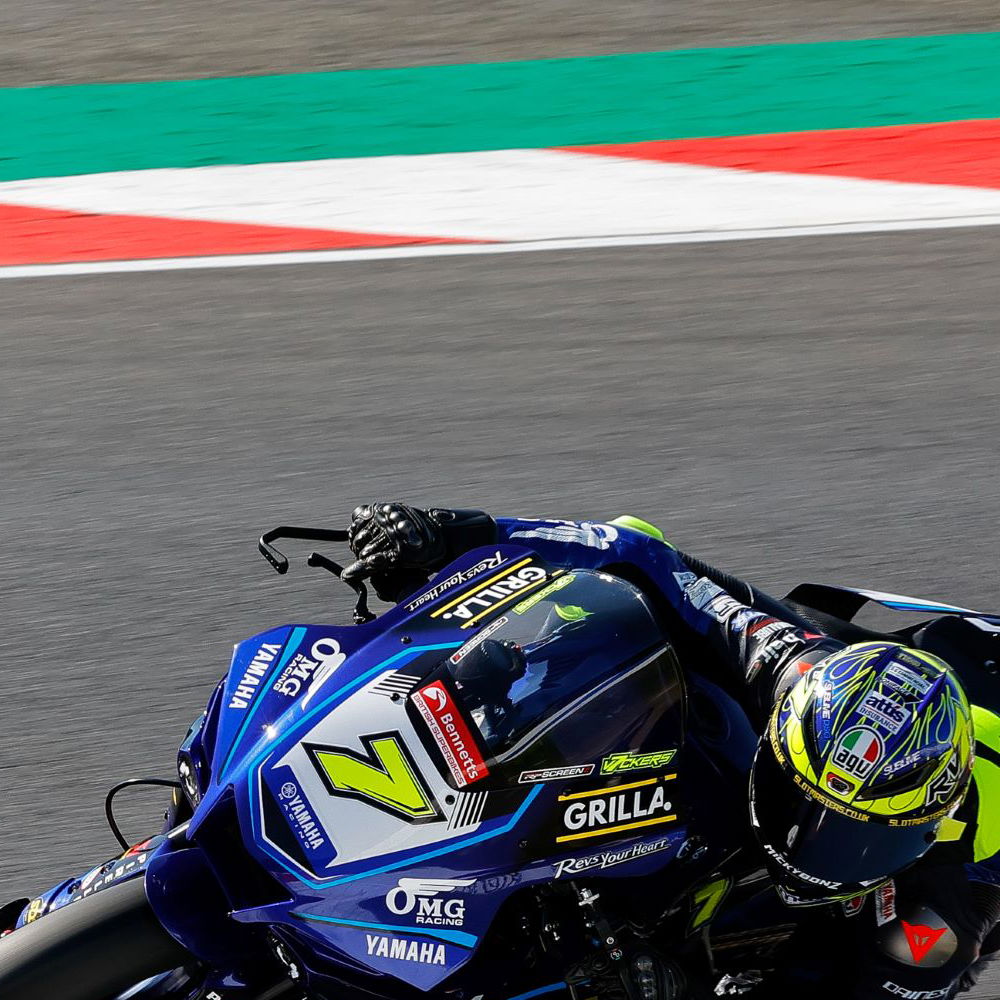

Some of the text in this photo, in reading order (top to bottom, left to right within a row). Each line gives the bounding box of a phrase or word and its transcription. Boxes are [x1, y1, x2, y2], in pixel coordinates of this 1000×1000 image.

[229, 643, 282, 709] YAMAHA
[273, 653, 303, 691] RACING
[279, 638, 342, 697] OMG
[413, 694, 465, 785] BRITISH SUPERBIKES
[440, 713, 478, 779] Bennetts
[859, 708, 898, 733] INSURANCE
[305, 732, 446, 822] 7
[278, 793, 311, 849] RACING
[290, 794, 326, 850] YAMAHA
[552, 855, 599, 879] Revs
[386, 884, 466, 919] OMG
[415, 916, 464, 927] RACING
[365, 934, 446, 966] YAMAHA
